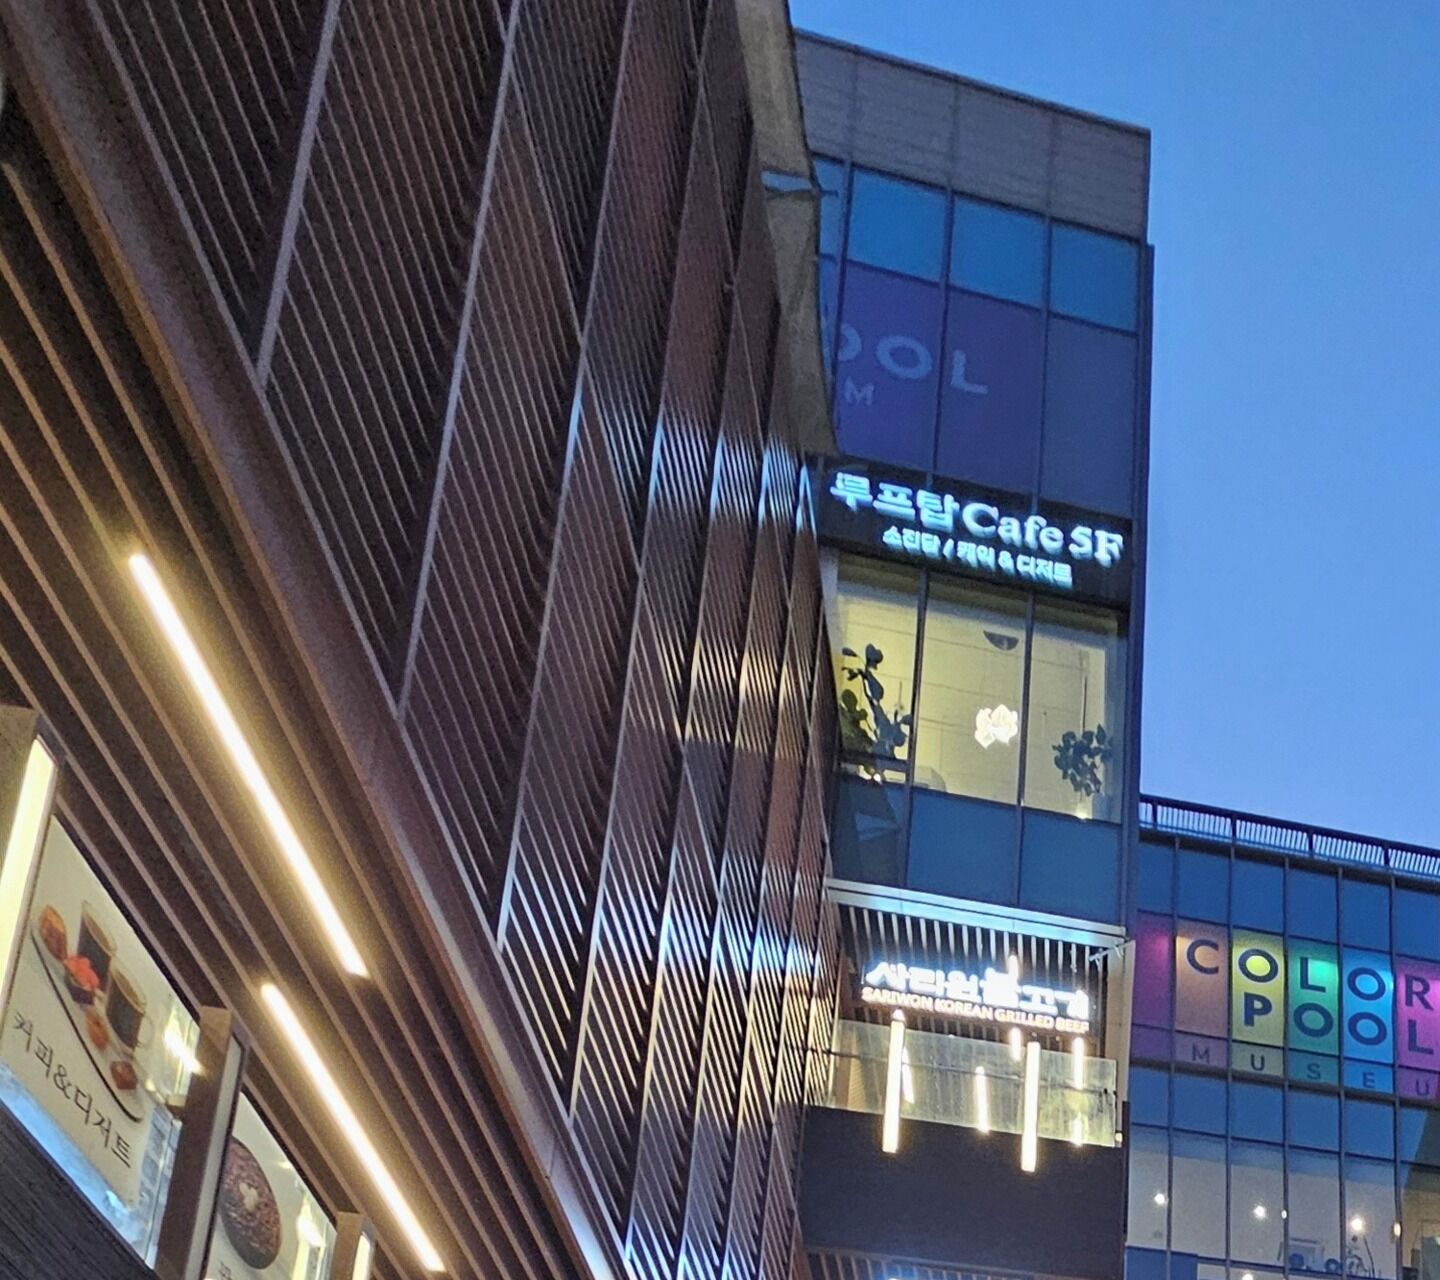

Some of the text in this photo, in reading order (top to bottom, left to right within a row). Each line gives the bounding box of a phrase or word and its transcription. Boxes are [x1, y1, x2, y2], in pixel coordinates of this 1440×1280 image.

[829, 471, 1124, 568] 루프탑 Cafe SF
[861, 986, 1090, 1034] SARIWON KOREAN GRILLED BEEF
[1185, 938, 1434, 1012] COLOR
[1242, 991, 1434, 1056] POOL
[13, 1011, 132, 1169] 커피&디저트
